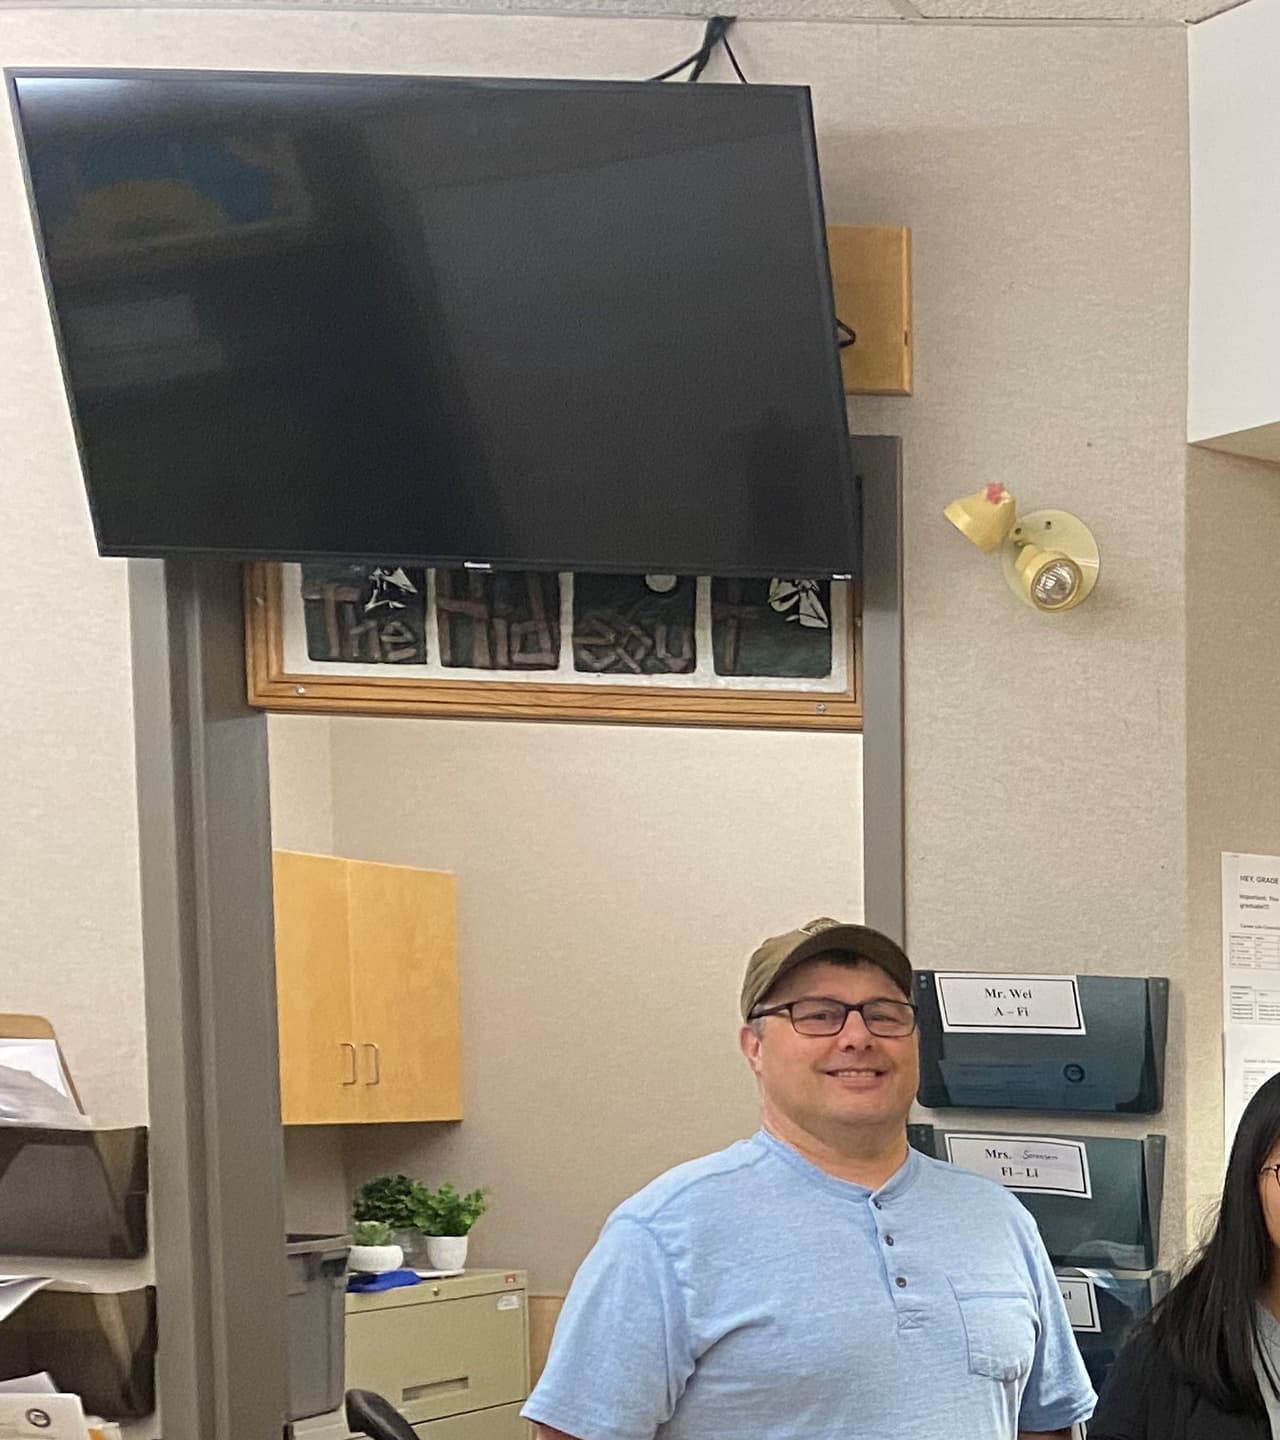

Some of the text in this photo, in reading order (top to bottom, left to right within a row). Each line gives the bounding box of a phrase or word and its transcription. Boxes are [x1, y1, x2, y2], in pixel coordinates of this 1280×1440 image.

[985, 988, 1032, 999] Mr. Wei
[994, 1007, 1003, 1017] A
[985, 1149, 1012, 1159] Mrs.
